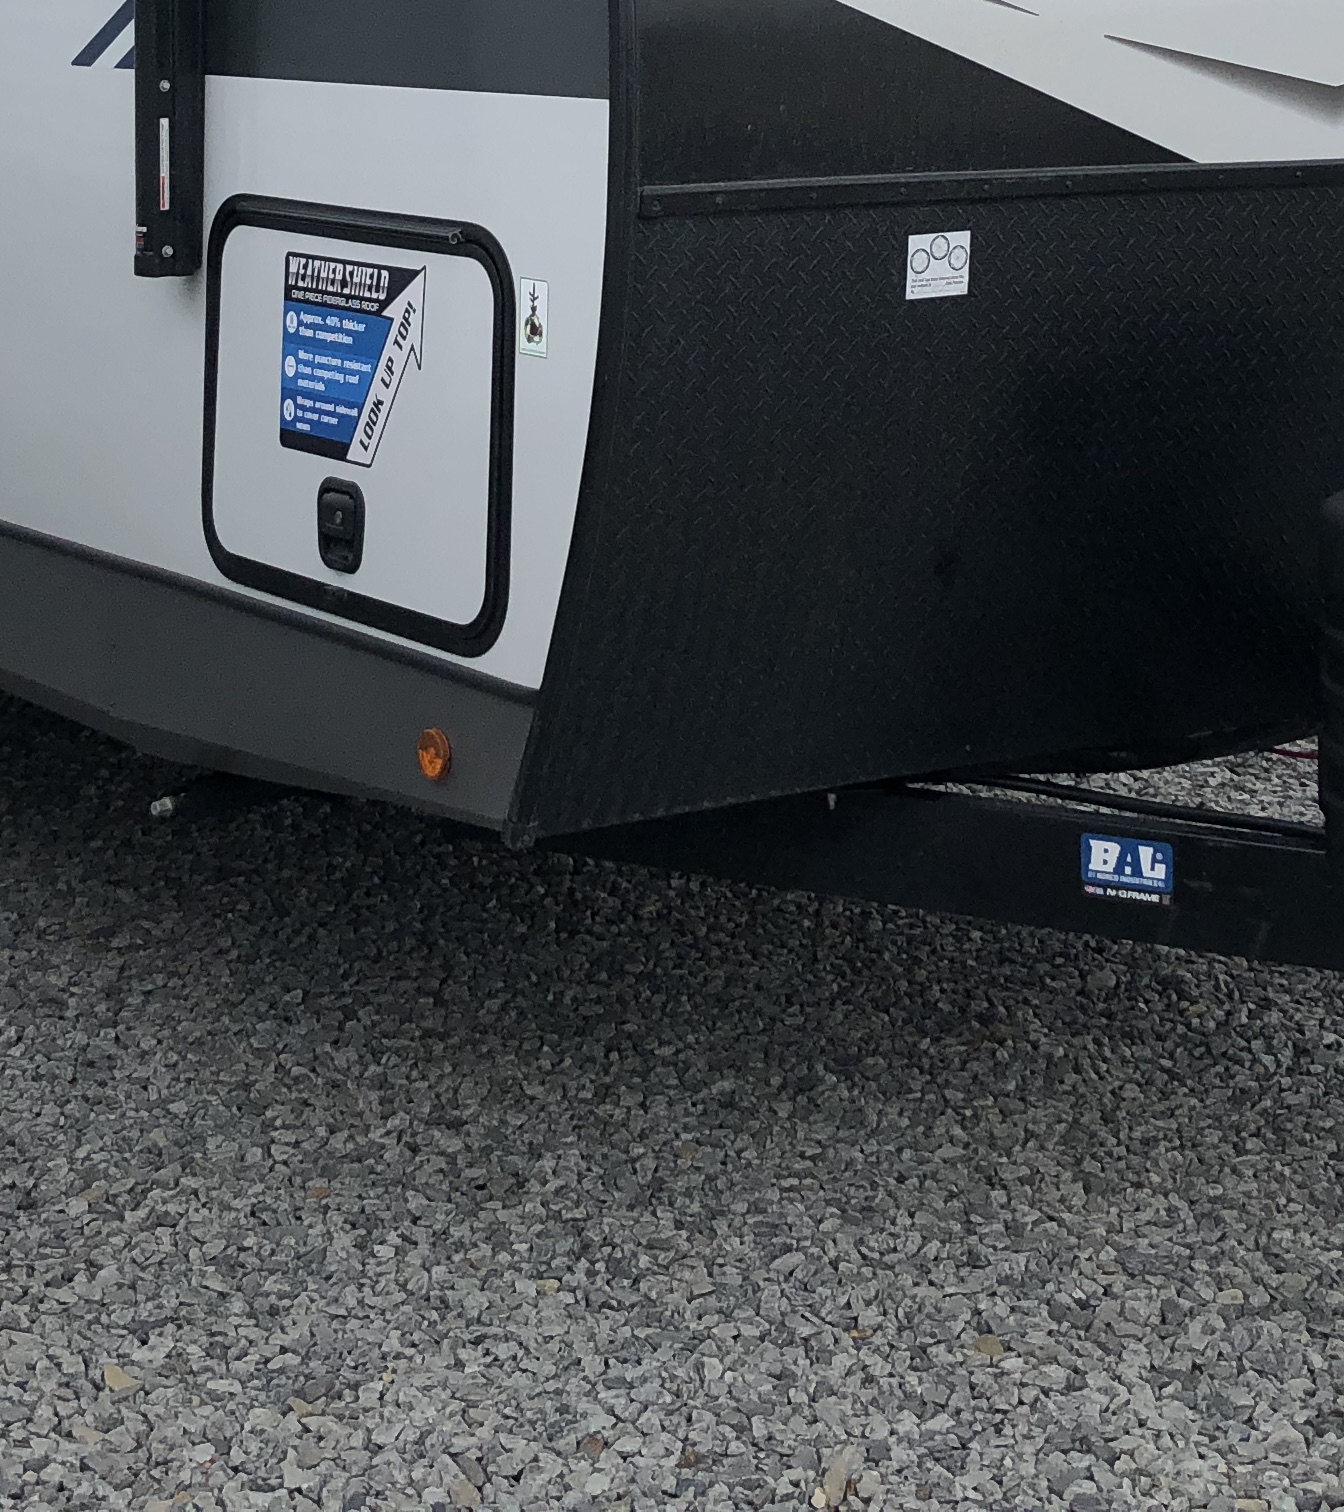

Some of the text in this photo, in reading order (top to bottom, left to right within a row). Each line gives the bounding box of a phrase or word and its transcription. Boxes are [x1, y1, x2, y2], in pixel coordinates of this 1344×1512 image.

[288, 256, 390, 300] WEATHER SHIELD
[291, 290, 380, 312] ONE PIECE FIBERGLASS ROOF
[359, 300, 417, 453] LOOK UP TOP!
